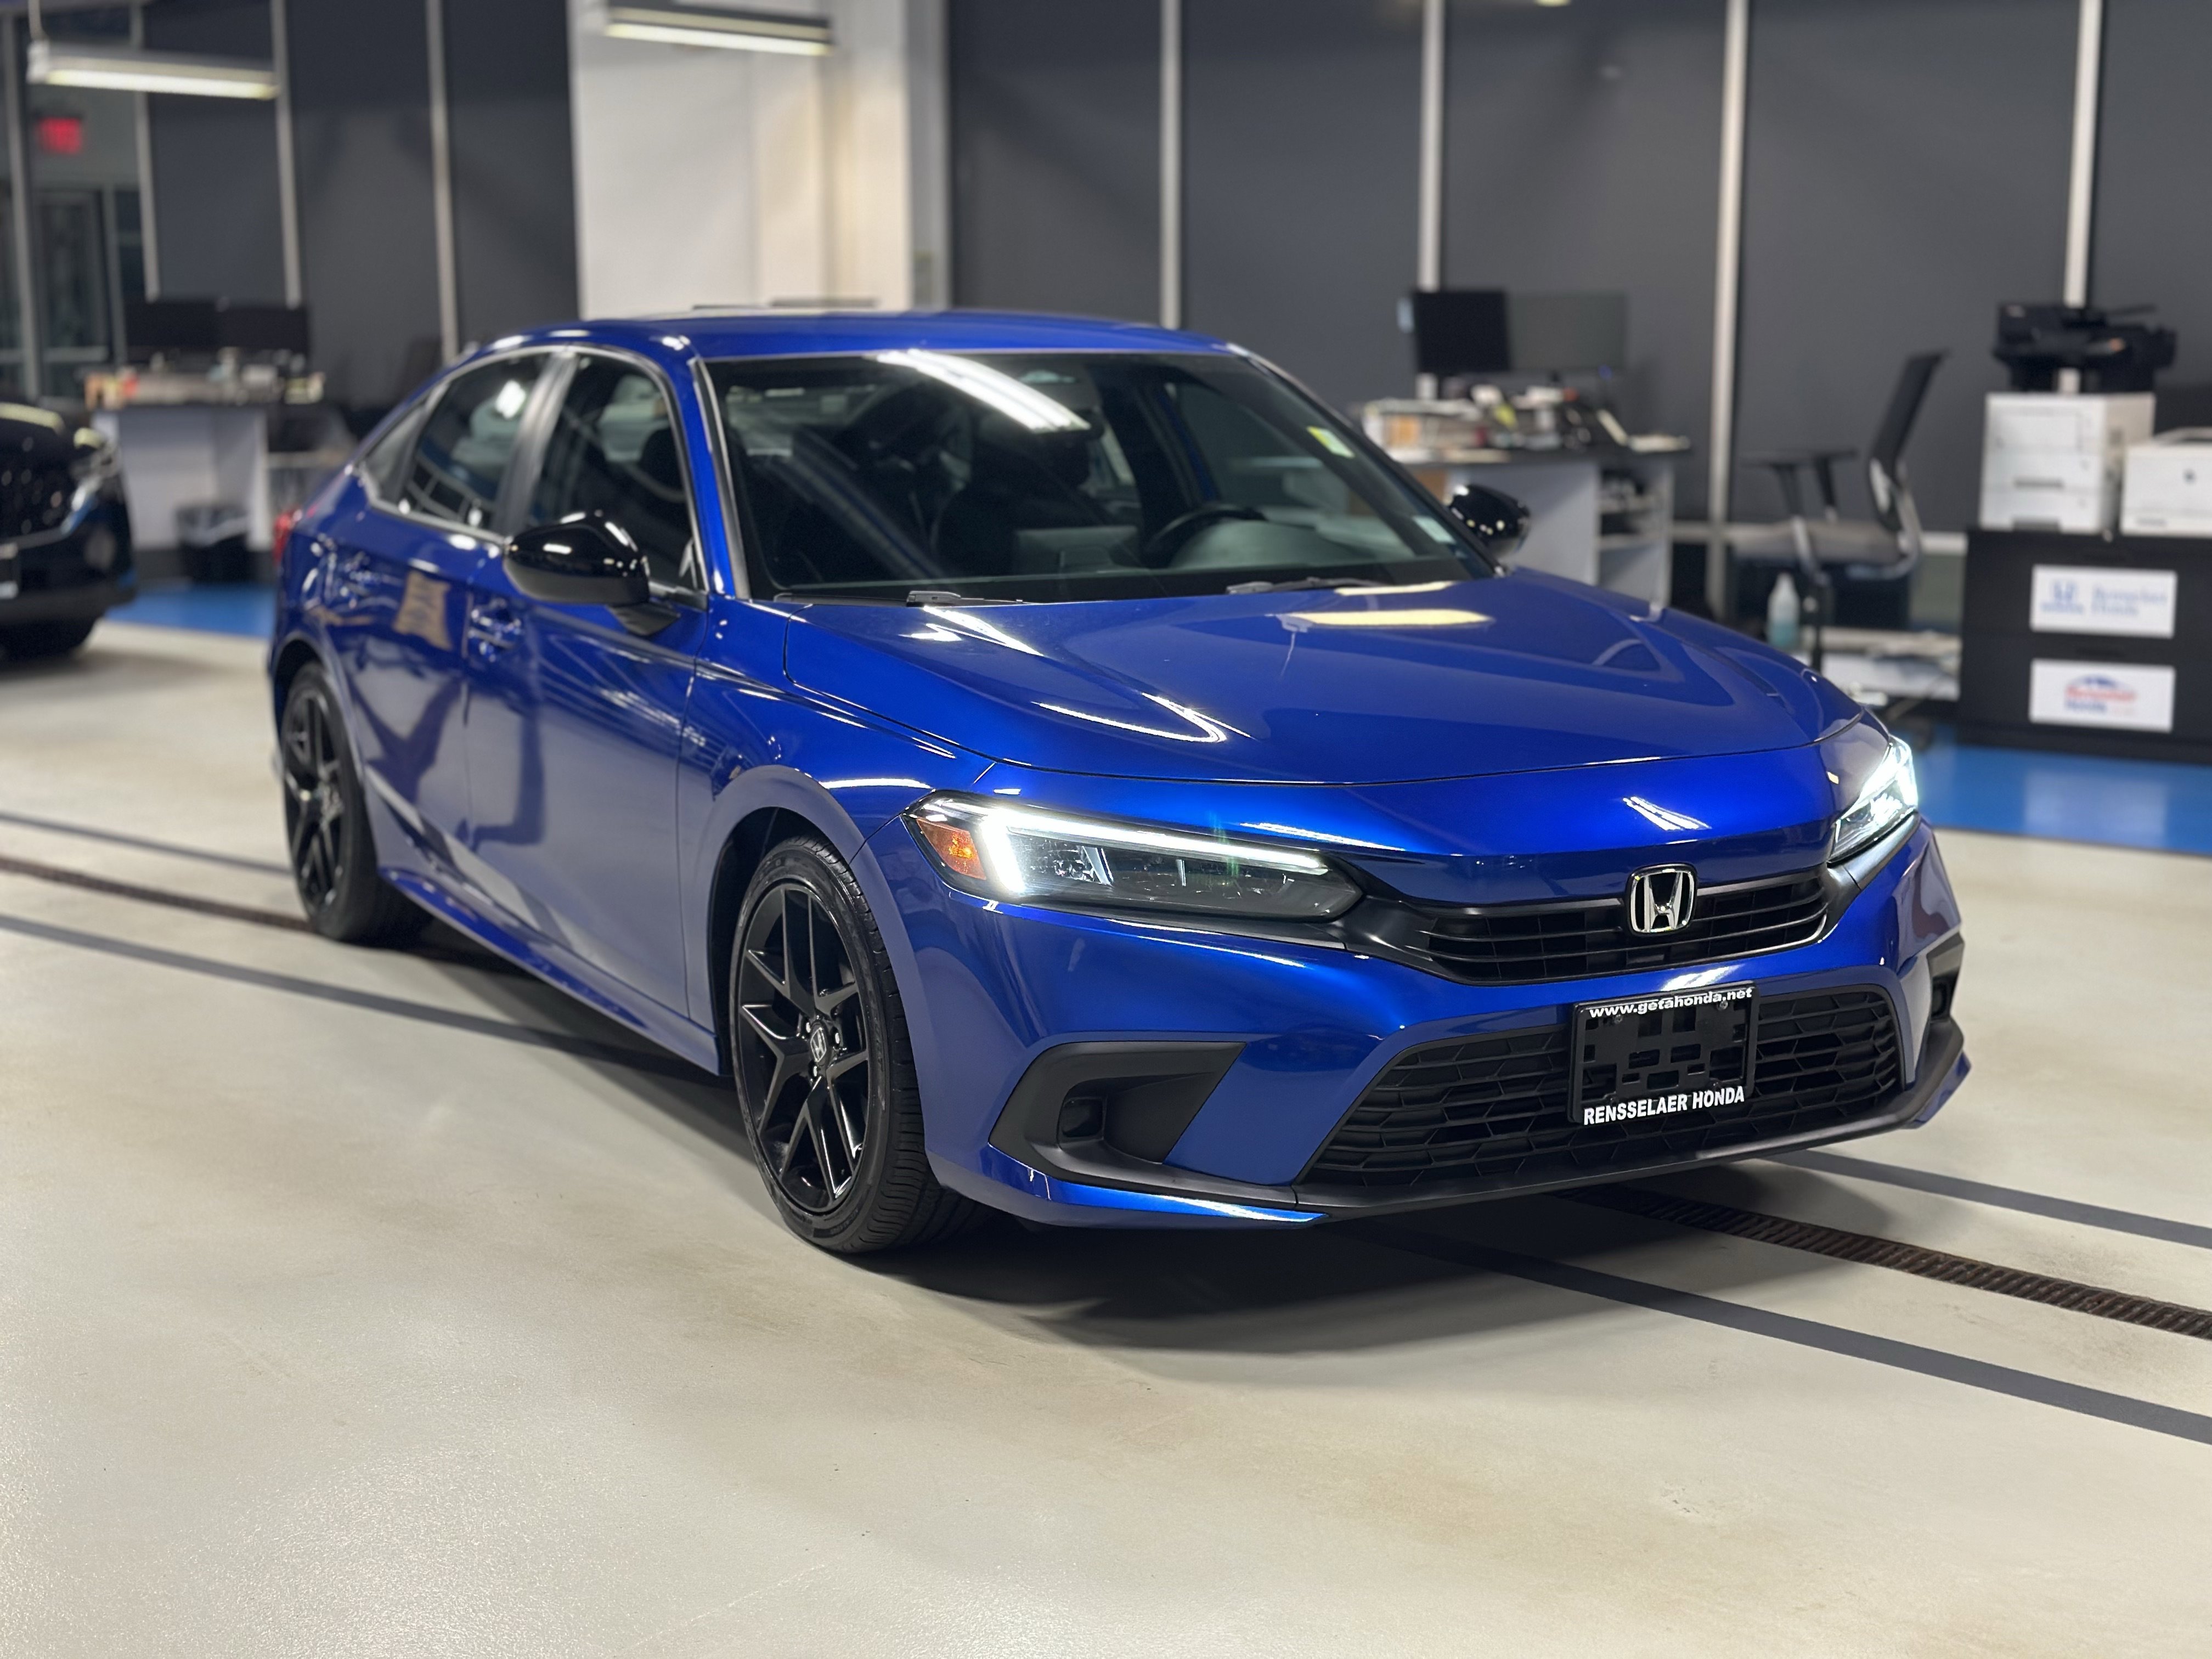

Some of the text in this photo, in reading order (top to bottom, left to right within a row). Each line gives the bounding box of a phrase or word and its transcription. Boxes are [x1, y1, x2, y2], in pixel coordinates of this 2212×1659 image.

[1589, 988, 1752, 1018] www.getahonda.net
[1583, 1086, 1745, 1125] RENSSELAER HONDA
